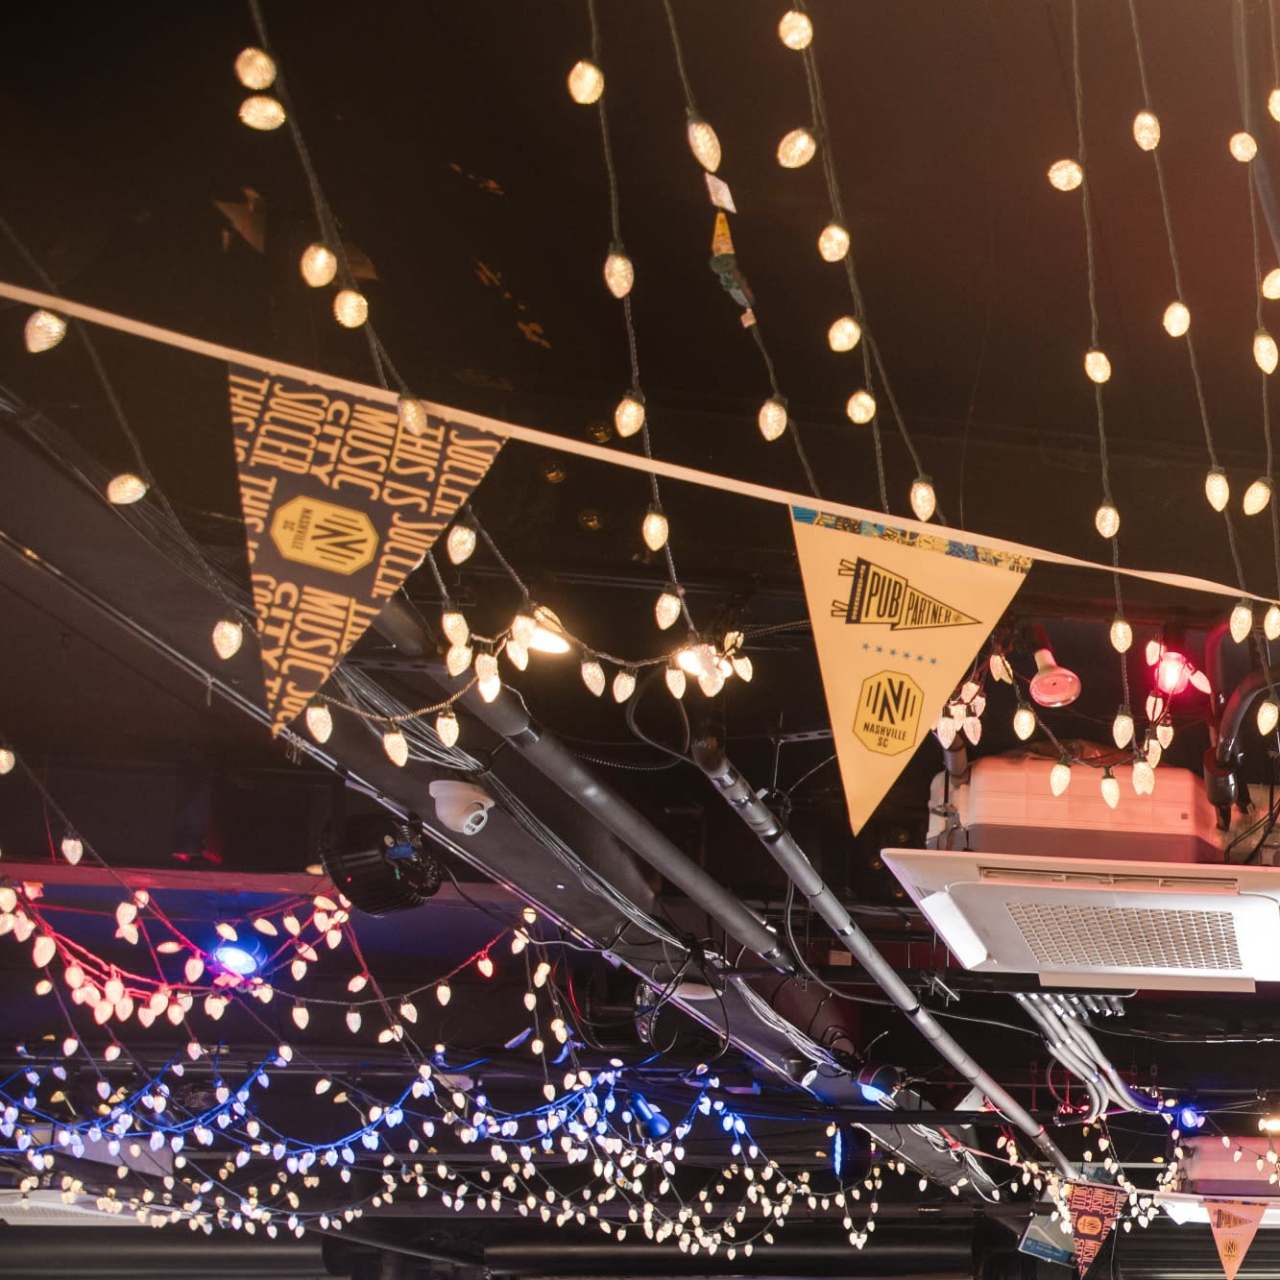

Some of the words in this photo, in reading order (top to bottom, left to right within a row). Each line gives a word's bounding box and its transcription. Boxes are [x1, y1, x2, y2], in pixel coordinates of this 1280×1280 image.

[249, 382, 331, 476] SOCCER
[307, 399, 351, 486] CITY
[331, 403, 399, 501] MUSIC
[293, 507, 313, 552] NASHVILLE
[381, 484, 433, 514] IS
[264, 580, 299, 671] CITY
[866, 570, 901, 619] PUB
[904, 591, 952, 627] PARTNER
[279, 585, 350, 686] MUSIC
[862, 720, 908, 742] NASHVILLE
[876, 736, 890, 749] SC
